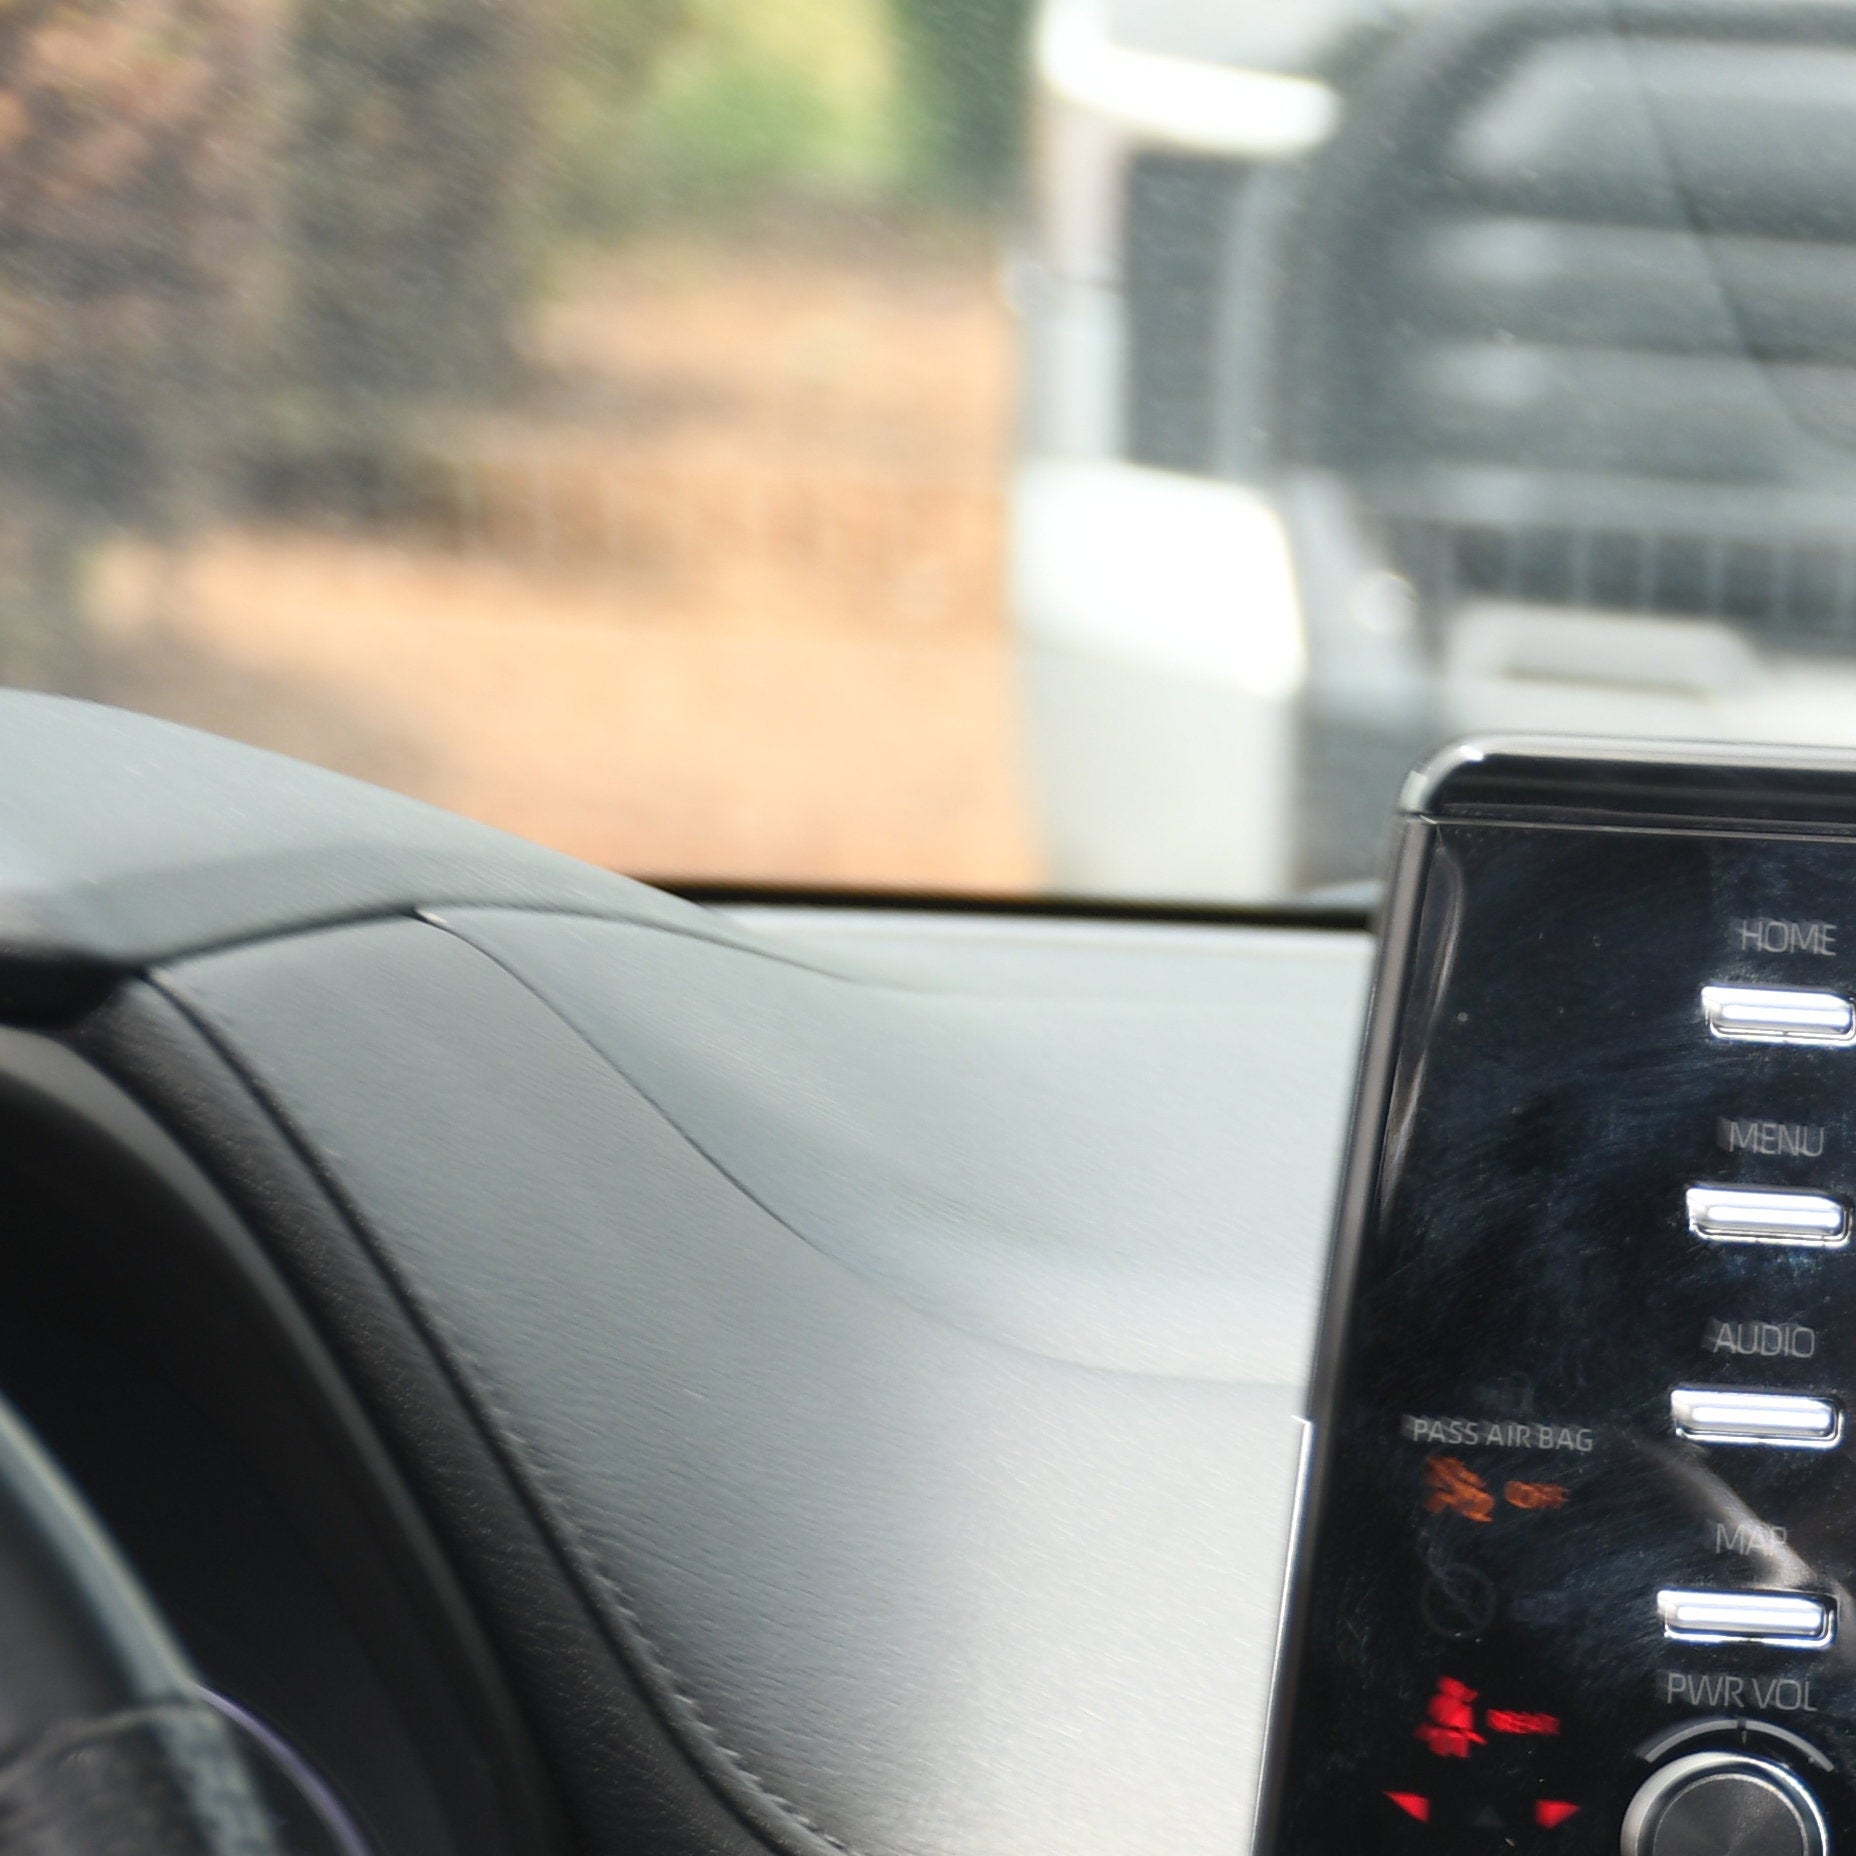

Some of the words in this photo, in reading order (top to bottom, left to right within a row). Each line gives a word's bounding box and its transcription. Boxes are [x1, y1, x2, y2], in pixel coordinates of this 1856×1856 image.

[1739, 919, 1838, 957] HOME
[1727, 1122, 1825, 1158] MENU
[1713, 1321, 1816, 1359] AUDIO
[1412, 1417, 1478, 1447] PASS
[1486, 1421, 1531, 1450] AIR
[1538, 1424, 1594, 1453] BAG
[1715, 1522, 1788, 1557] MAP
[1666, 1674, 1745, 1708] PWR
[1752, 1679, 1817, 1713] VOL
